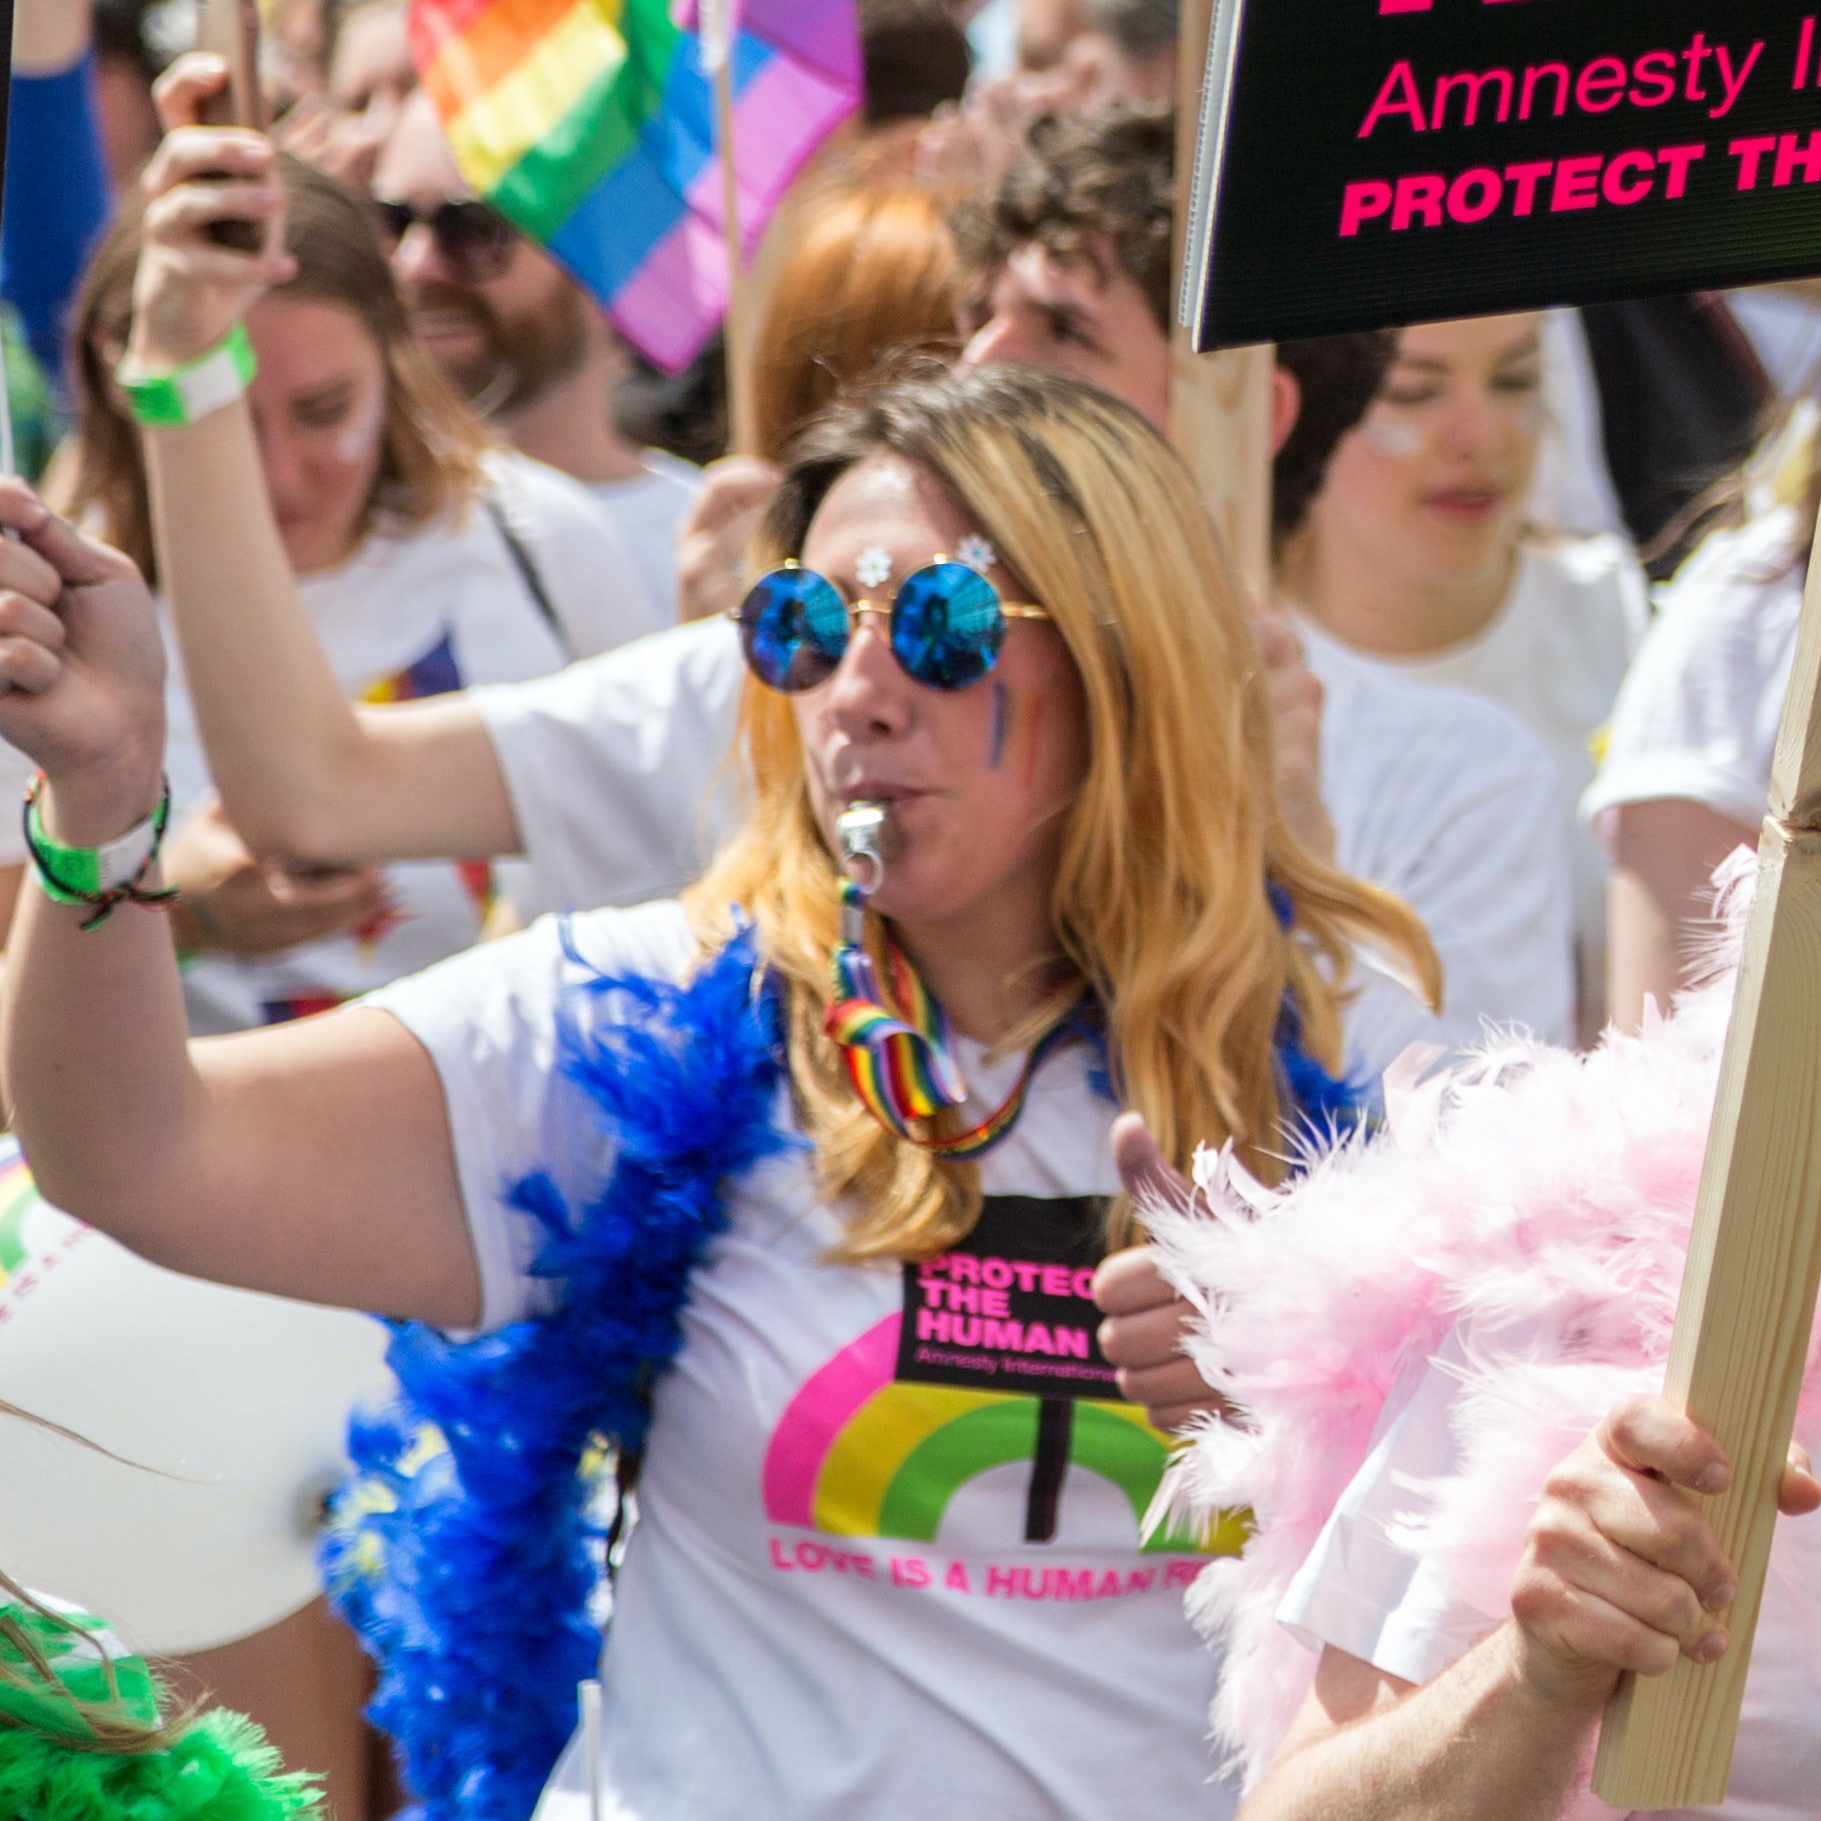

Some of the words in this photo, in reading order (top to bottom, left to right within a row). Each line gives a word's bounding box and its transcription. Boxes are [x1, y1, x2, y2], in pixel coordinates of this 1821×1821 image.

[1358, 27, 1764, 139] Amnesty
[1338, 144, 1706, 238] PROTECT
[918, 1253, 1095, 1301] PROTEC
[918, 1280, 1011, 1319] THE
[916, 1309, 1090, 1359] HUMAN
[914, 1345, 998, 1376] Amnesty
[1002, 1354, 1117, 1383] Internationa
[769, 1537, 877, 1581] LOVE
[889, 1556, 933, 1589] IS
[944, 1561, 971, 1595] A
[985, 1563, 1157, 1602] HUMAN
